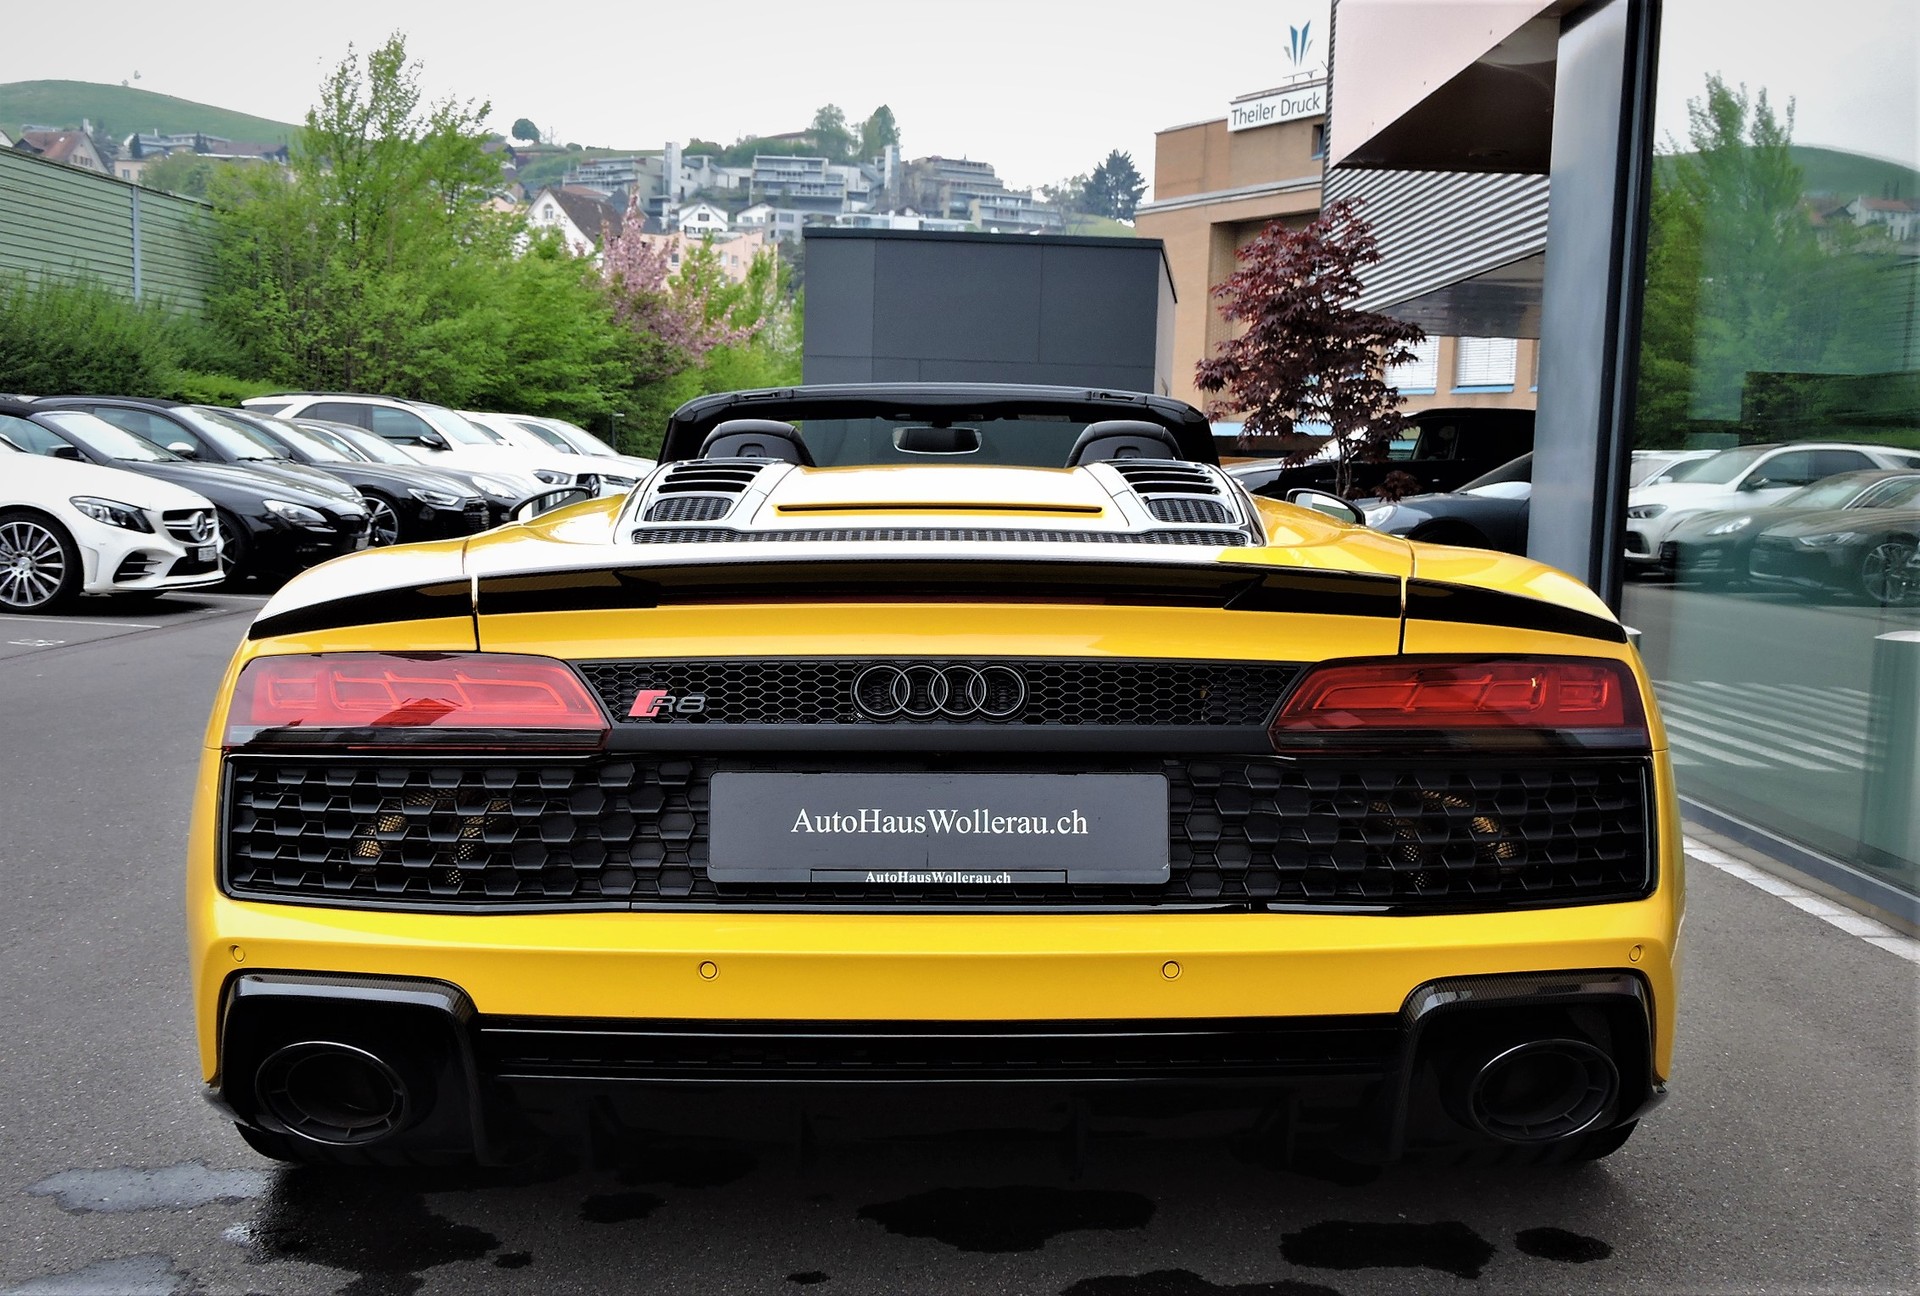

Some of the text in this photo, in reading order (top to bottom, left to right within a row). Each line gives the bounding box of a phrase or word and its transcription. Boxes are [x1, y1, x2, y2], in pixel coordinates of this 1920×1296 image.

[1231, 91, 1321, 126] Theiler Druck
[642, 694, 706, 714] R8
[790, 808, 1089, 835] AutoHausWollerau.ch
[865, 871, 1012, 884] AutoHausWollerau.ch
